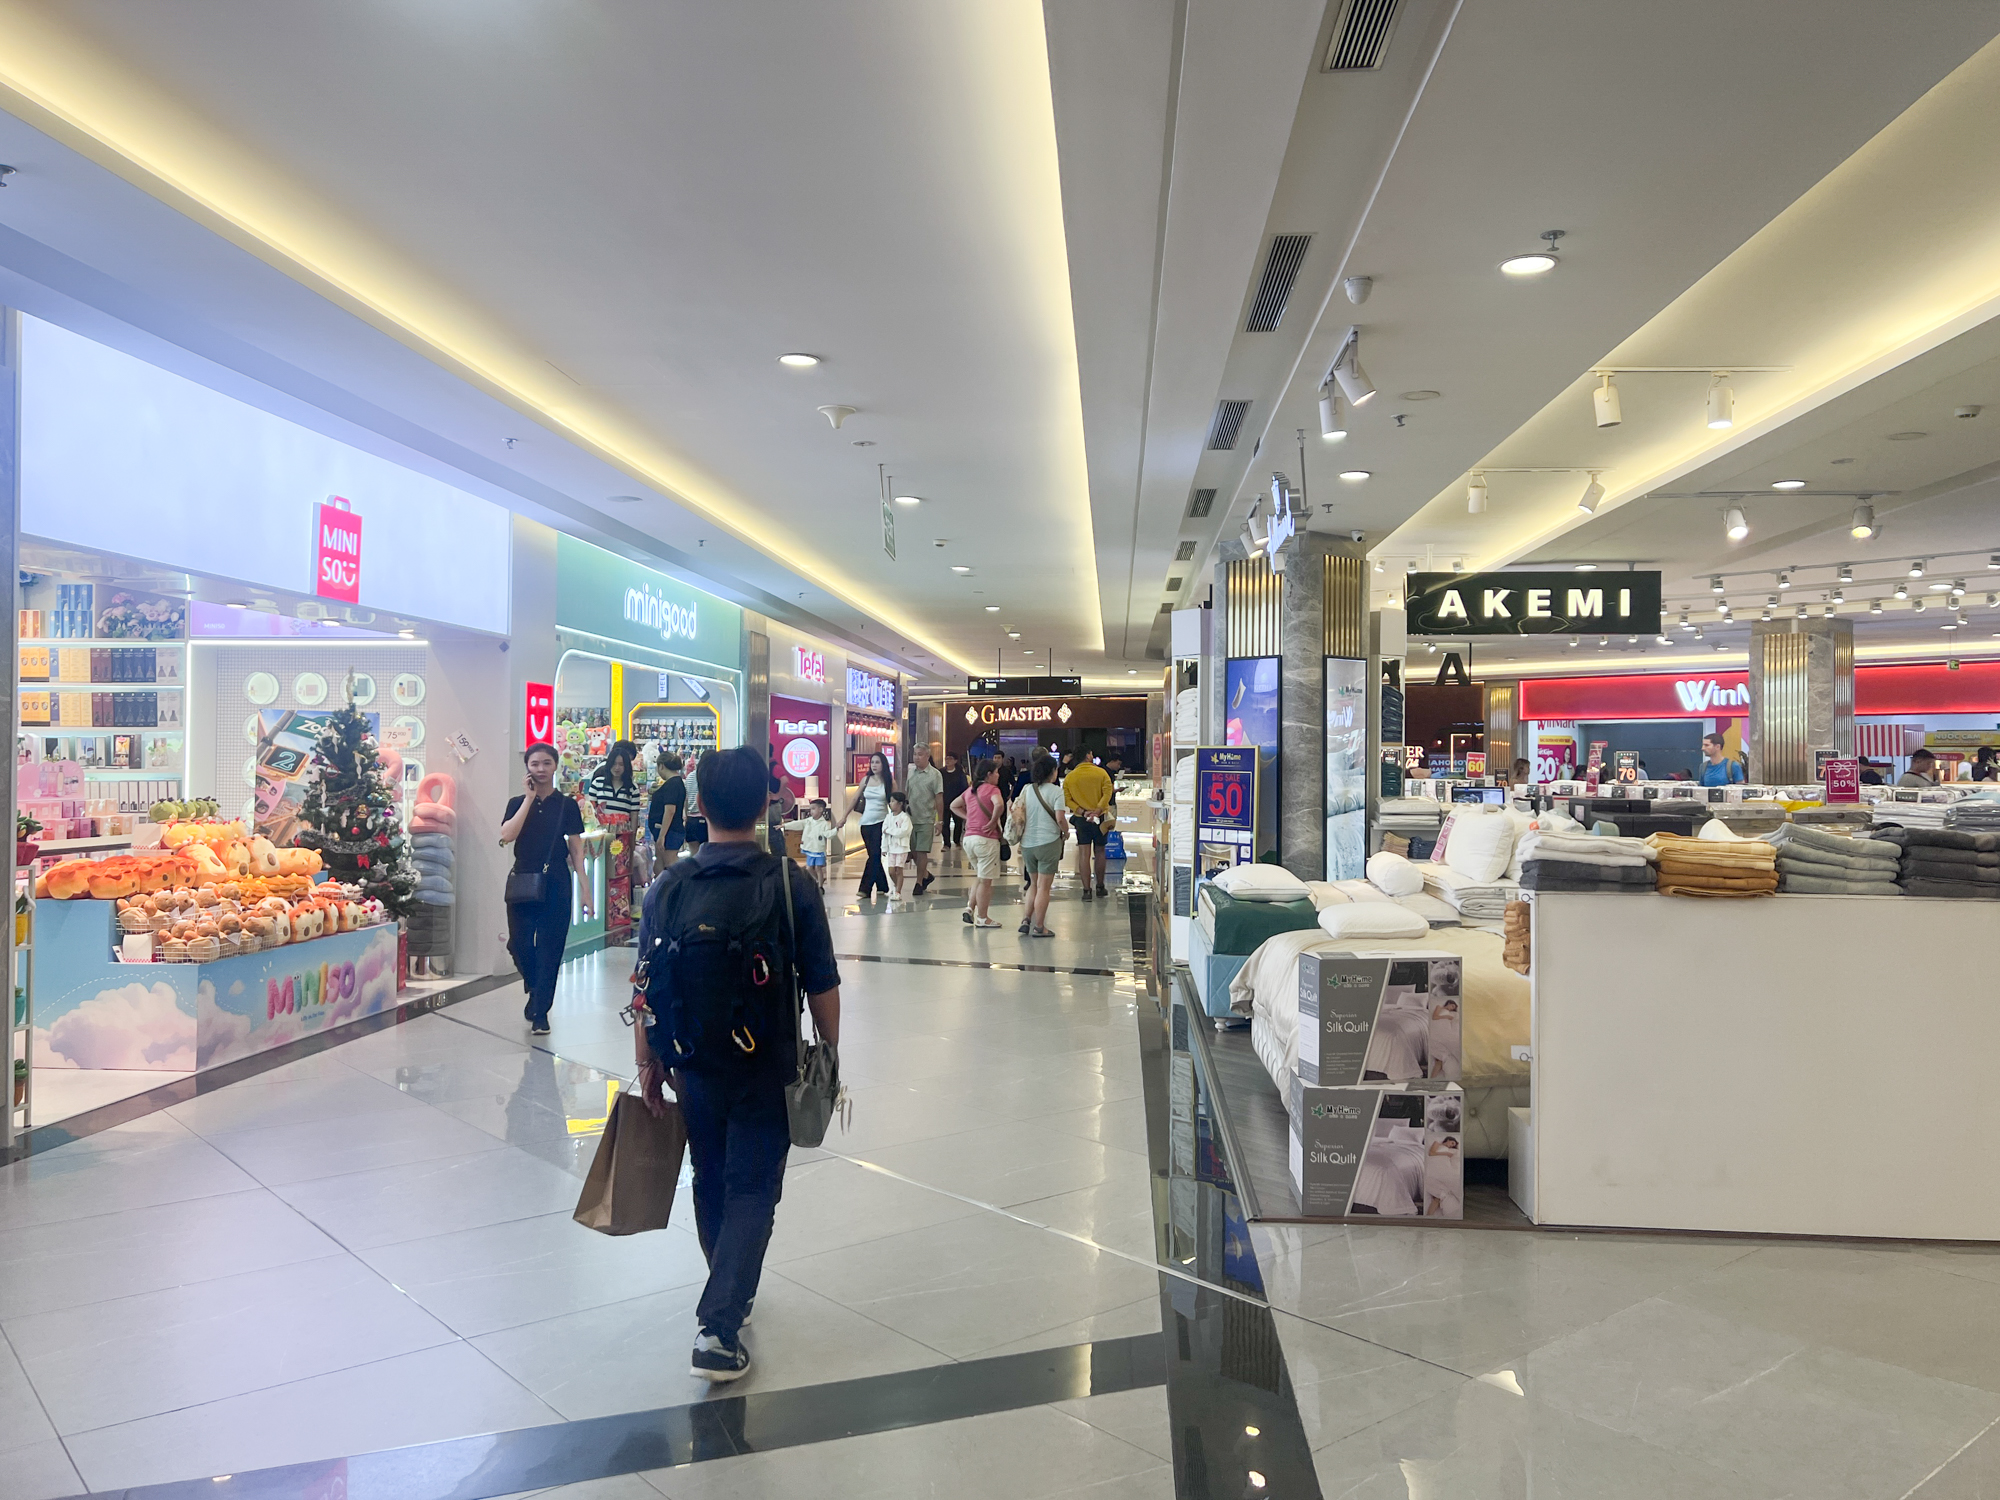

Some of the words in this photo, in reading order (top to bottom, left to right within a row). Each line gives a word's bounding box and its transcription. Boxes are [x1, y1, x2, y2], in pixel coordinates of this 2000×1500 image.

[322, 524, 357, 556] MINI
[1437, 588, 1631, 618] AKEMI
[623, 582, 697, 640] minigood
[793, 646, 827, 684] Tefal
[1675, 679, 1750, 711] WinM
[981, 704, 1051, 724] G.MASTER
[774, 719, 828, 735] Tefal
[271, 751, 297, 771] 2
[1468, 760, 1484, 773] 60
[1212, 773, 1223, 781] BIG
[1225, 774, 1240, 782] SALE
[1618, 767, 1636, 781] 70
[1833, 779, 1856, 788] 50%
[1341, 975, 1373, 984] MyHome
[1326, 1021, 1343, 1033] Silk
[1343, 1021, 1369, 1034] Quilt
[1326, 1105, 1361, 1115] MyHome
[1310, 1151, 1329, 1164] Silk
[1329, 1151, 1357, 1165] Quilt
